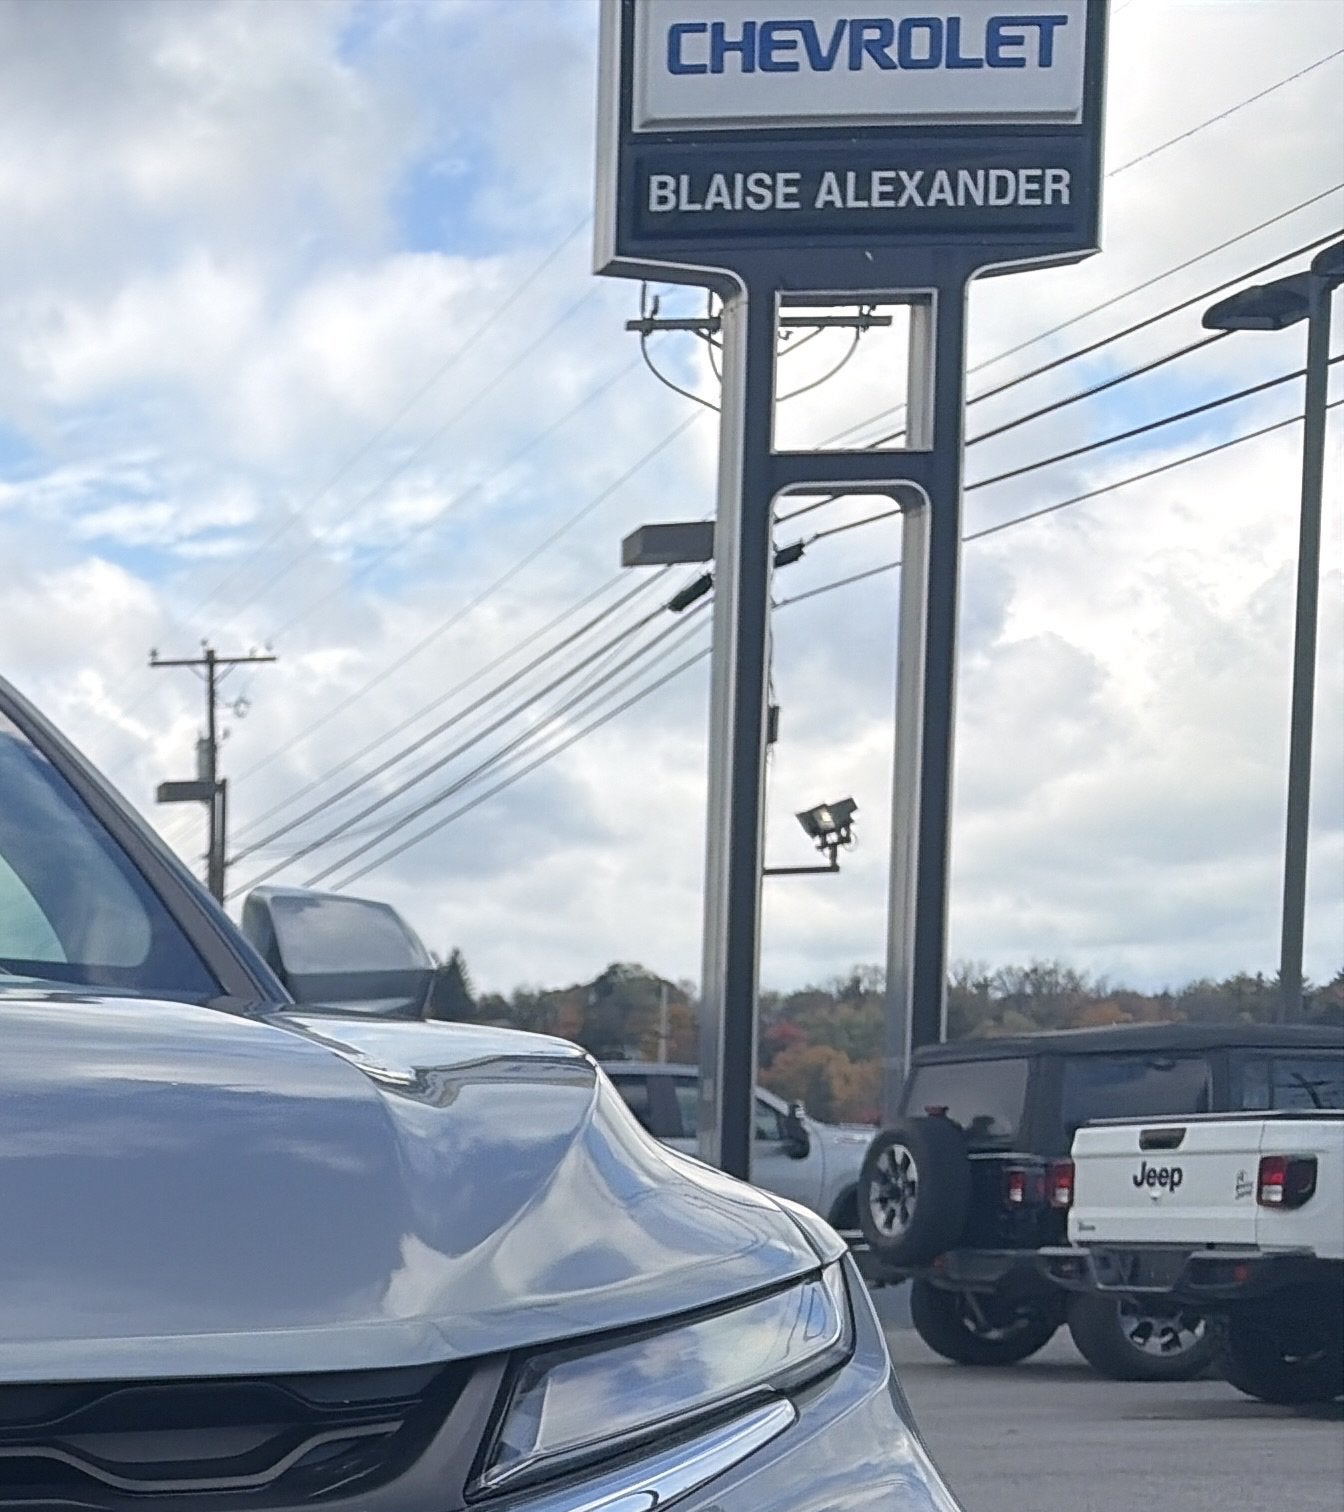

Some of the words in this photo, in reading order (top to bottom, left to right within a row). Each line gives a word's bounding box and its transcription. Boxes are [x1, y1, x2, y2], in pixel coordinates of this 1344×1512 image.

[666, 14, 1069, 76] CHEVROLET
[648, 171, 802, 213] BLAISE
[814, 168, 1072, 210] ALEXANDER
[1132, 1160, 1184, 1193] Jeep
